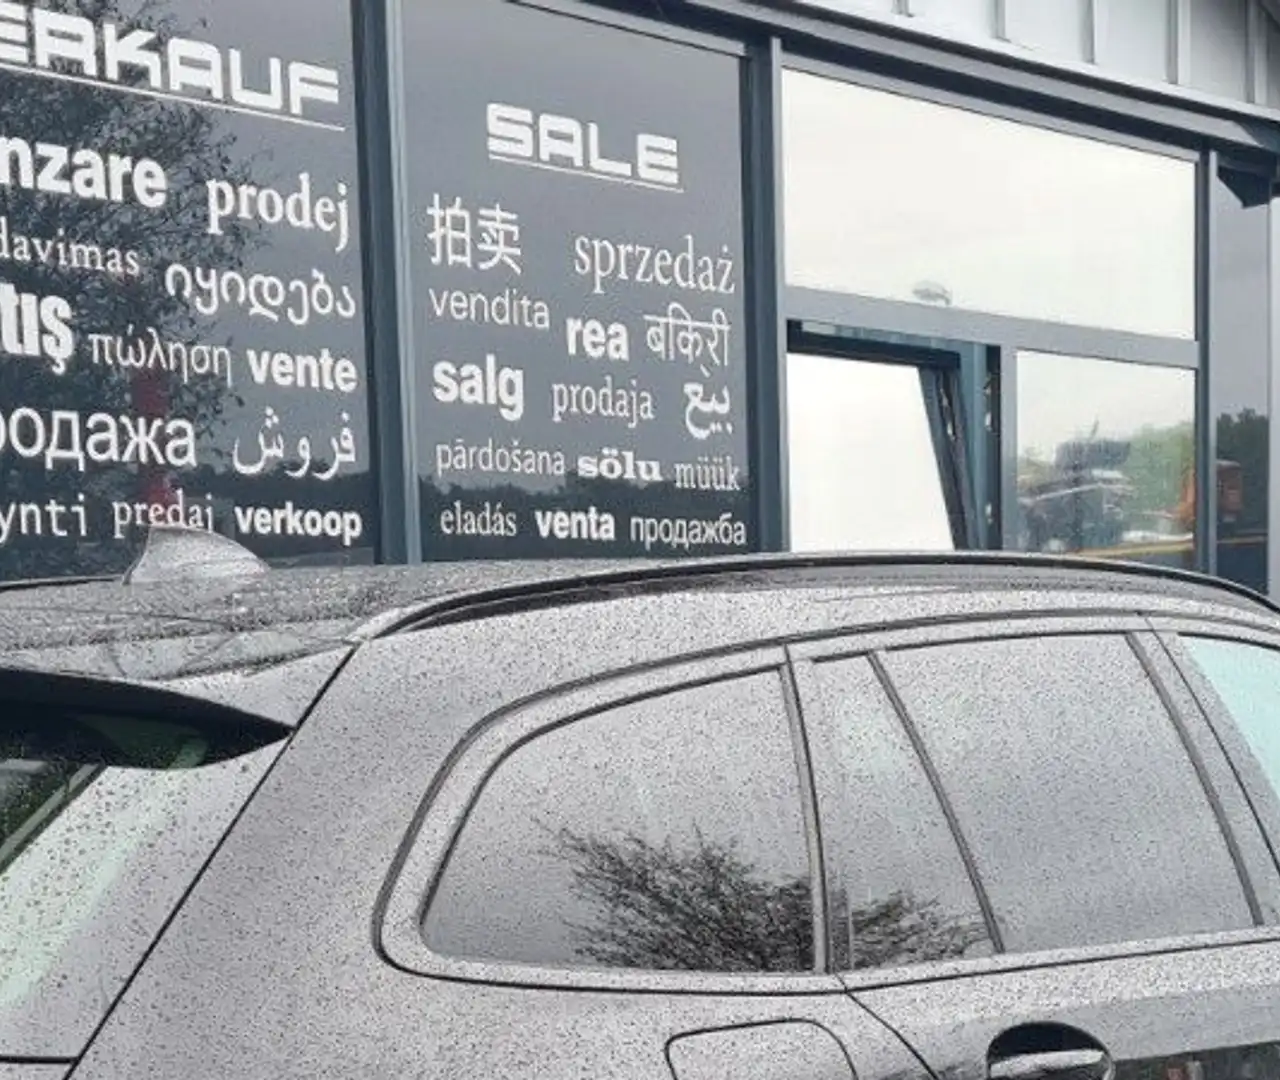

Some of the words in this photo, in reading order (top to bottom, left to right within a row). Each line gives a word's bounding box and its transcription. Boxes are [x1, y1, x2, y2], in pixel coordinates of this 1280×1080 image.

[486, 103, 678, 184] SALE
[206, 172, 349, 252] prodej
[426, 193, 521, 275] 拍卖
[574, 234, 735, 293] sprzedaż
[165, 264, 355, 325] იყიდება
[429, 288, 549, 330] vendita
[567, 316, 629, 361] rea
[88, 325, 232, 384] πώληση
[247, 347, 358, 392] vente
[433, 354, 524, 421] salg
[552, 375, 655, 428] prodaja
[233, 406, 356, 480] فروش
[435, 438, 565, 478] pārdošana
[577, 447, 664, 482] sölu
[674, 456, 740, 491] müük
[234, 500, 362, 546] verkoop
[440, 500, 517, 537] eladás
[535, 506, 616, 541] venta
[630, 513, 746, 551] продажба
